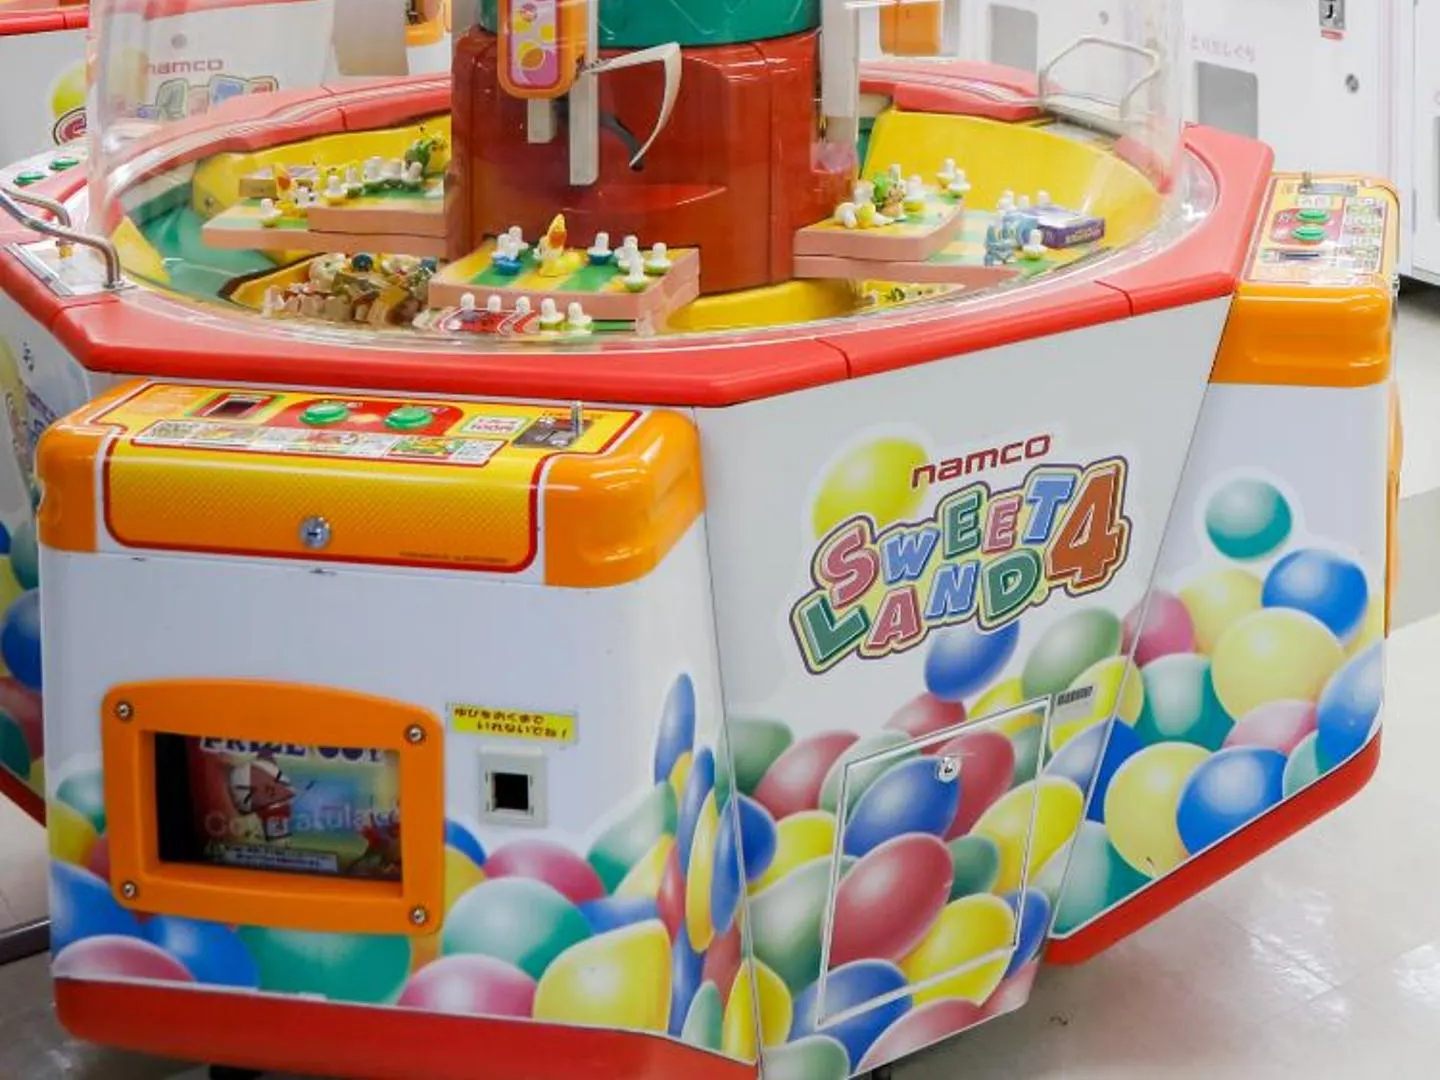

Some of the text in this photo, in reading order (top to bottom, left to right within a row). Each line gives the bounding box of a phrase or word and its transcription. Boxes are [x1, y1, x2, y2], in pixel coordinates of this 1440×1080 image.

[911, 433, 1052, 488] namco
[801, 461, 1128, 666] LAND 4
[821, 474, 1077, 610] SWEET
